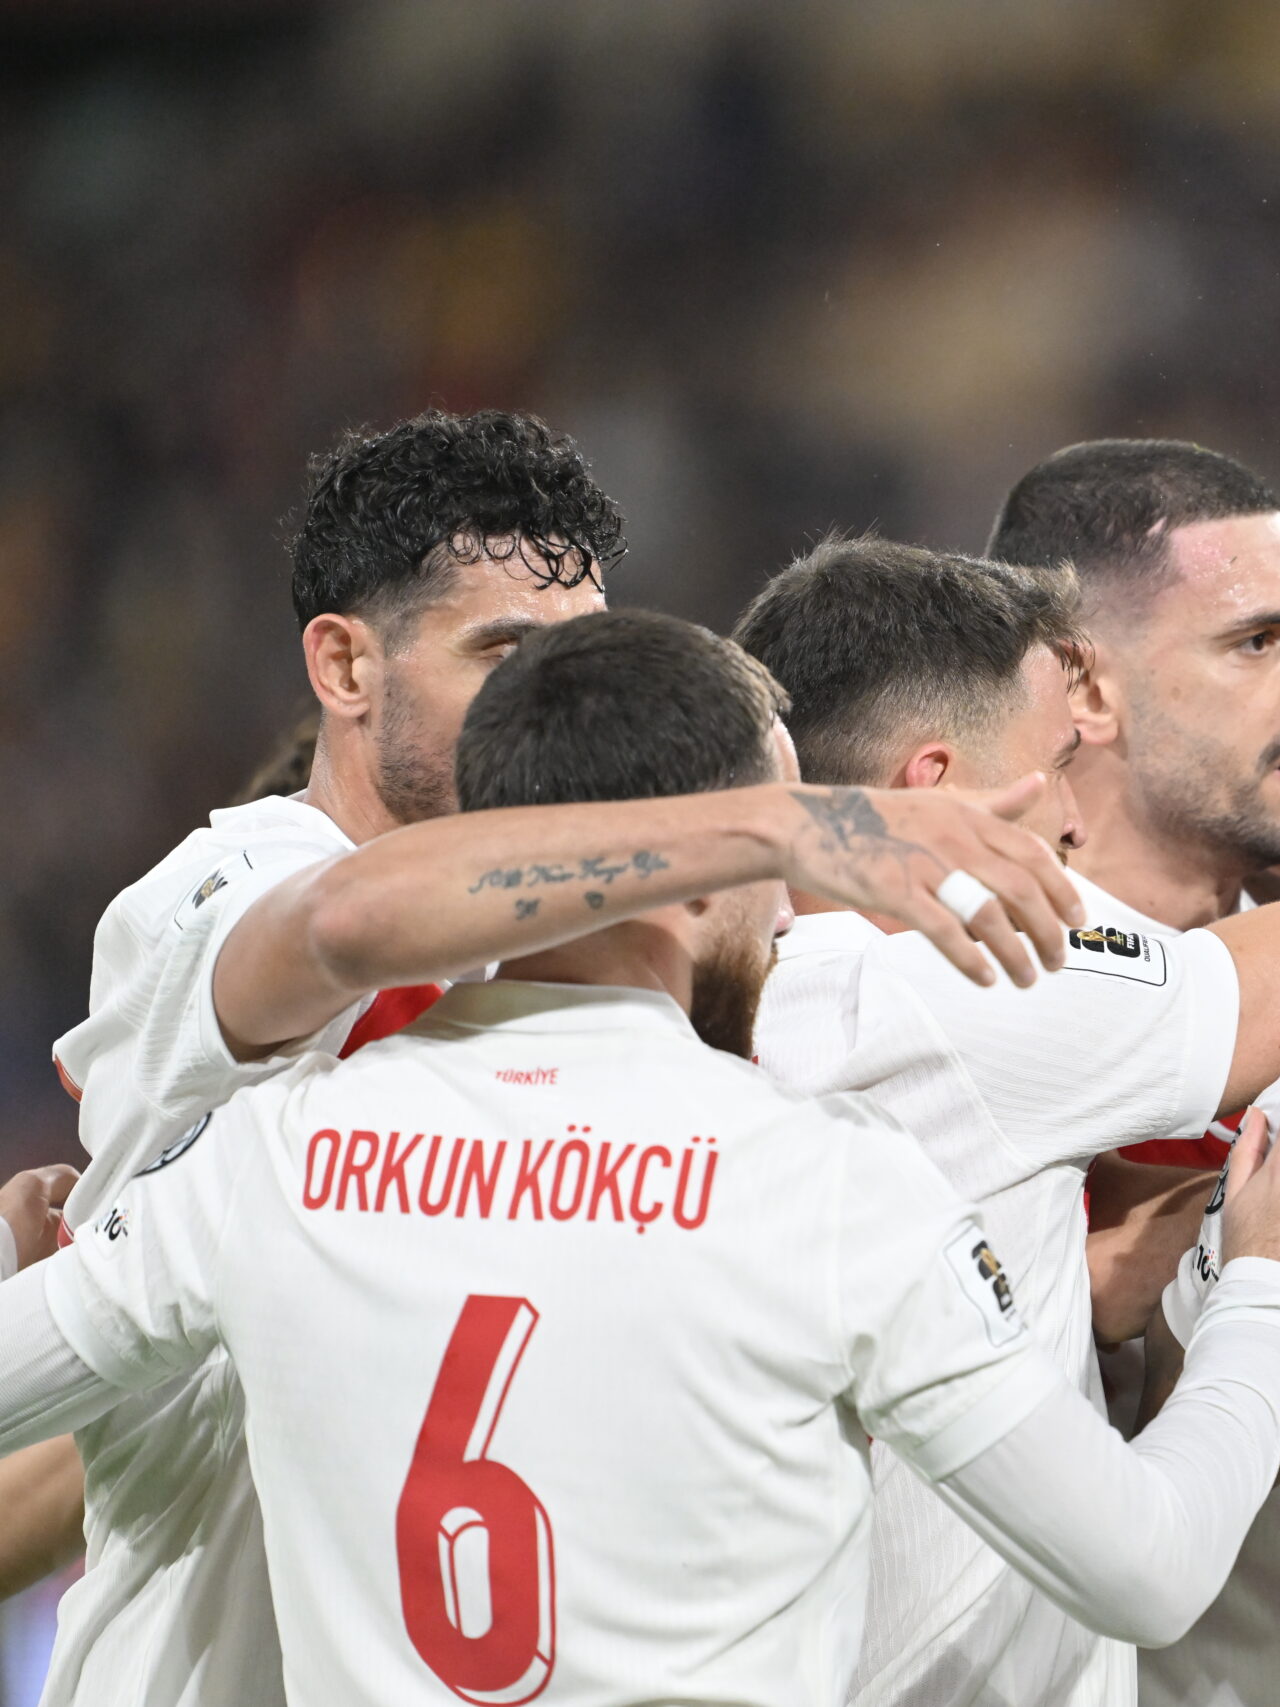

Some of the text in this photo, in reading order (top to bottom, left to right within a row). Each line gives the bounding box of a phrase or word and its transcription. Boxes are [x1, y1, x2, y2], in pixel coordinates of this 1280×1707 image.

[303, 1124, 719, 1235] ORKUN KÖKÇÜ
[395, 1293, 557, 1707] 6
